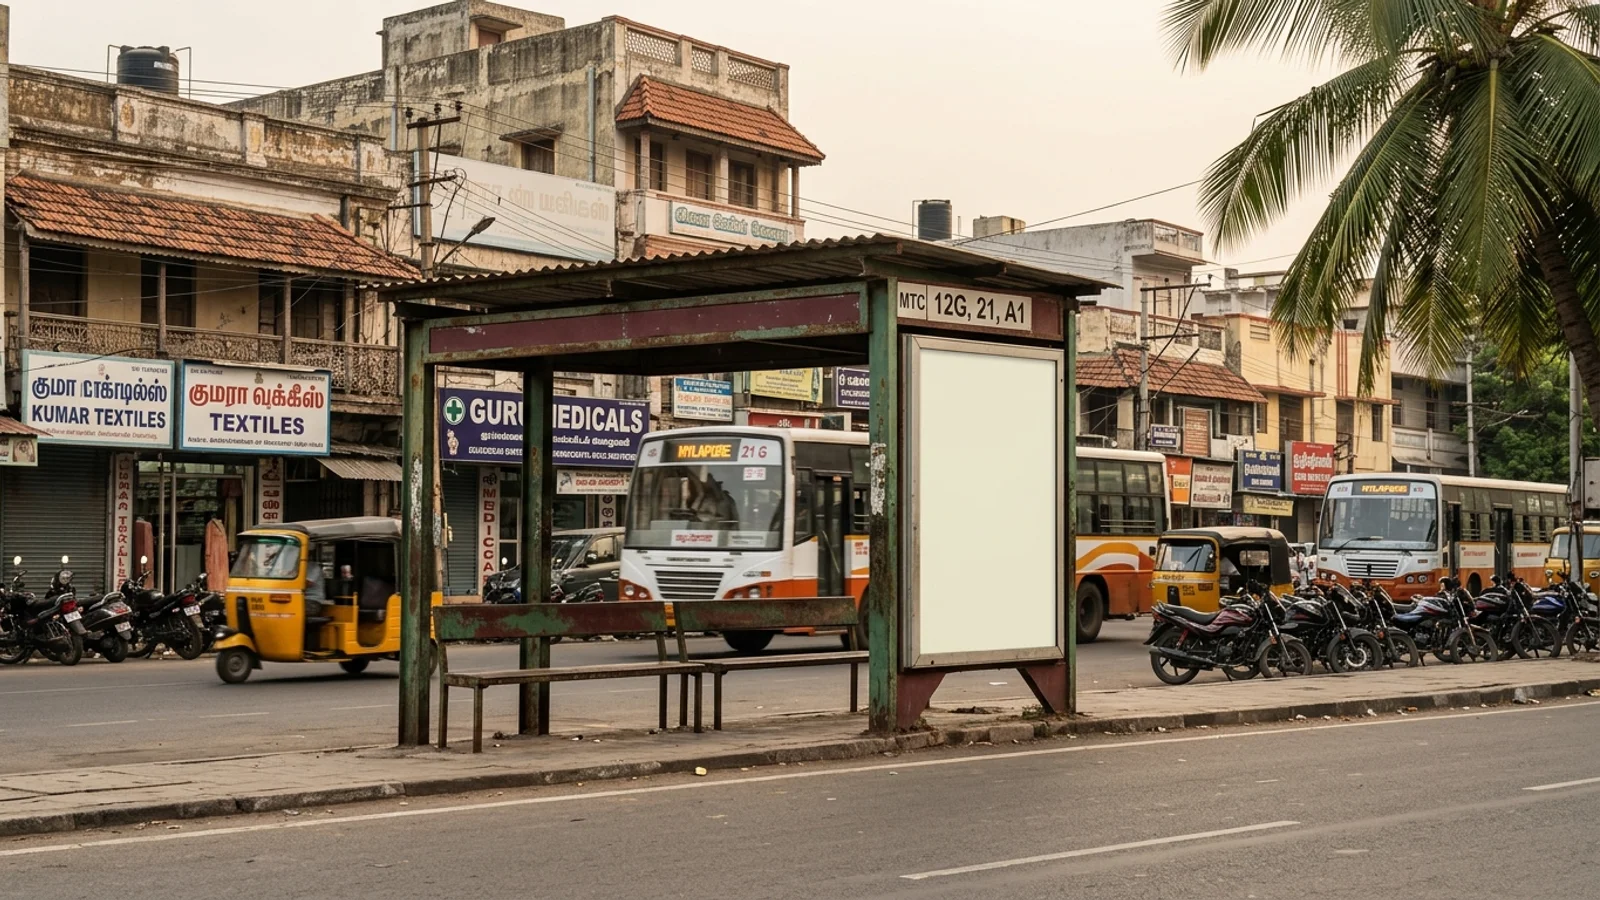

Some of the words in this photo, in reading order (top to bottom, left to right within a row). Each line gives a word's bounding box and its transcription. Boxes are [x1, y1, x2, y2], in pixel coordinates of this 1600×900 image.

[899, 291, 925, 310] MTC
[934, 291, 971, 321] 12G,
[976, 297, 1000, 325] 21,
[1004, 300, 1025, 324] A1
[32, 404, 90, 425] KUMAR
[94, 408, 166, 429] TEXTILES
[209, 412, 305, 435] TEXTILES
[553, 403, 644, 434] EDICALS
